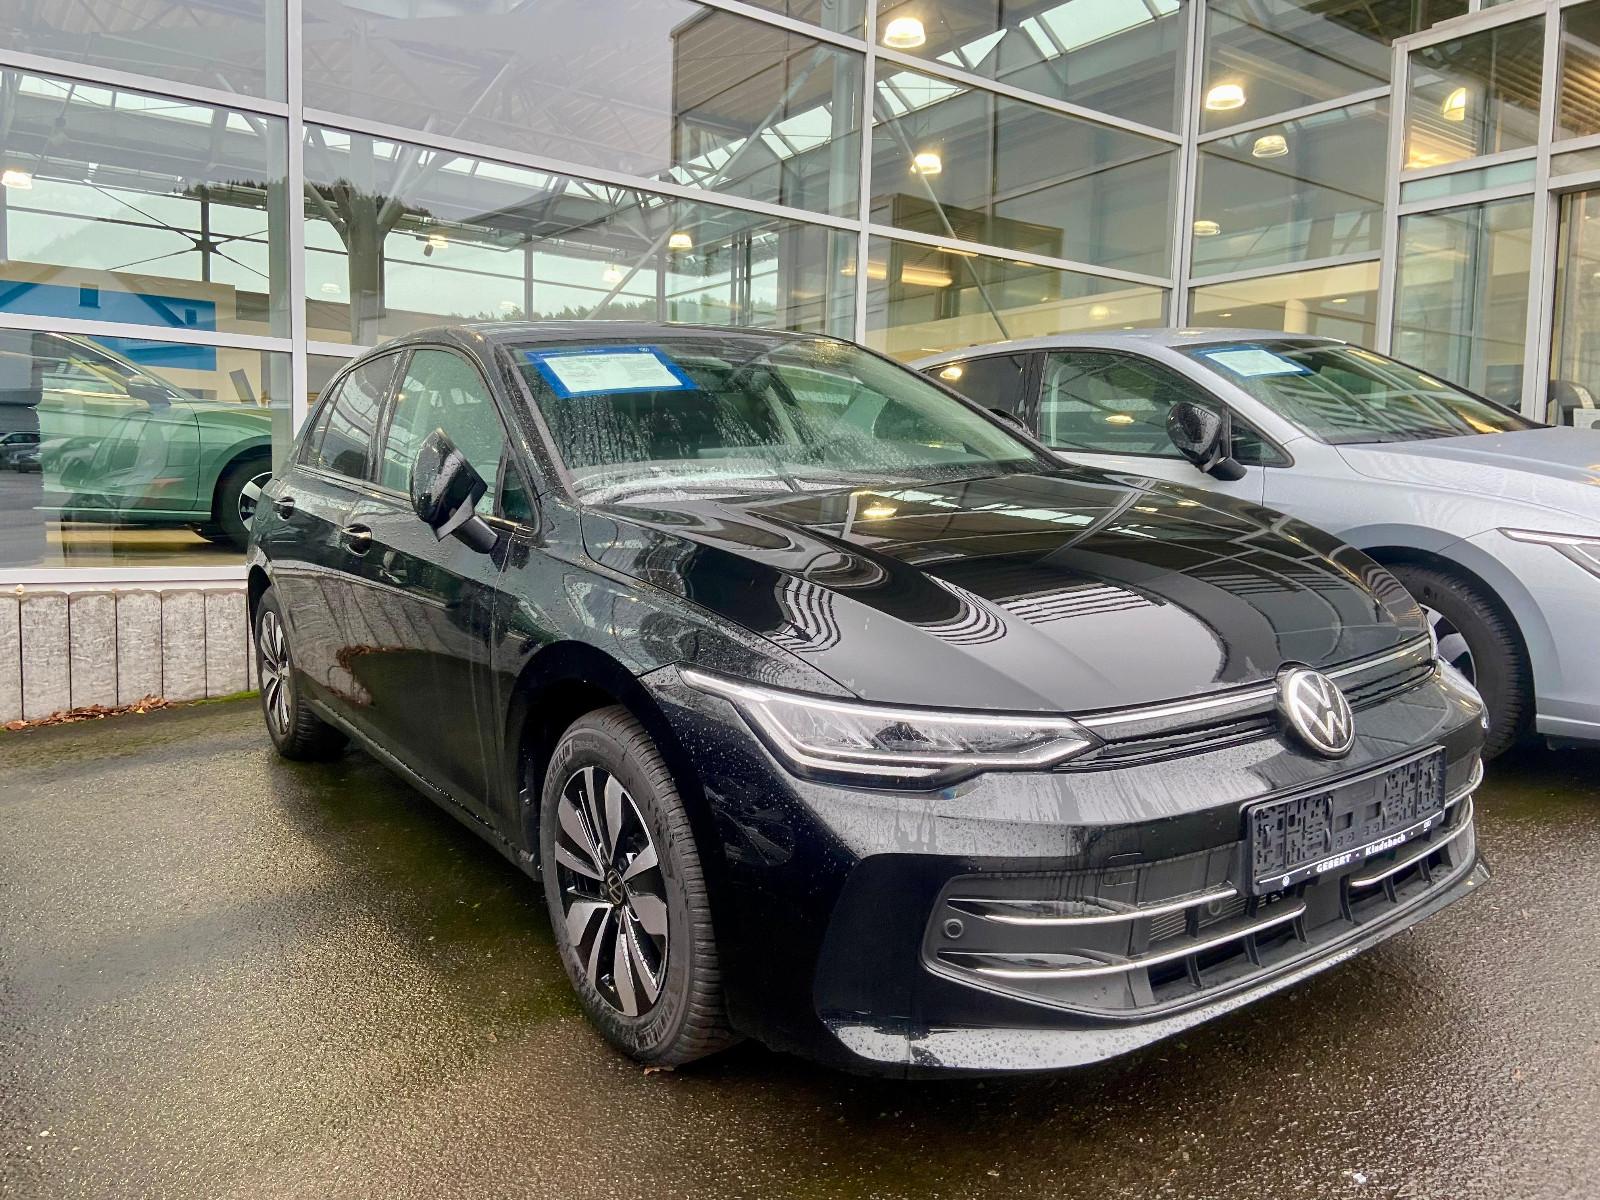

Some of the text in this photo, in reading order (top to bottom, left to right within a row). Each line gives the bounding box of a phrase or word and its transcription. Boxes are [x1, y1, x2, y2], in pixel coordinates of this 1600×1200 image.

[1292, 670, 1351, 748] VW
[1316, 833, 1406, 873] GEBERT Kindsbach
